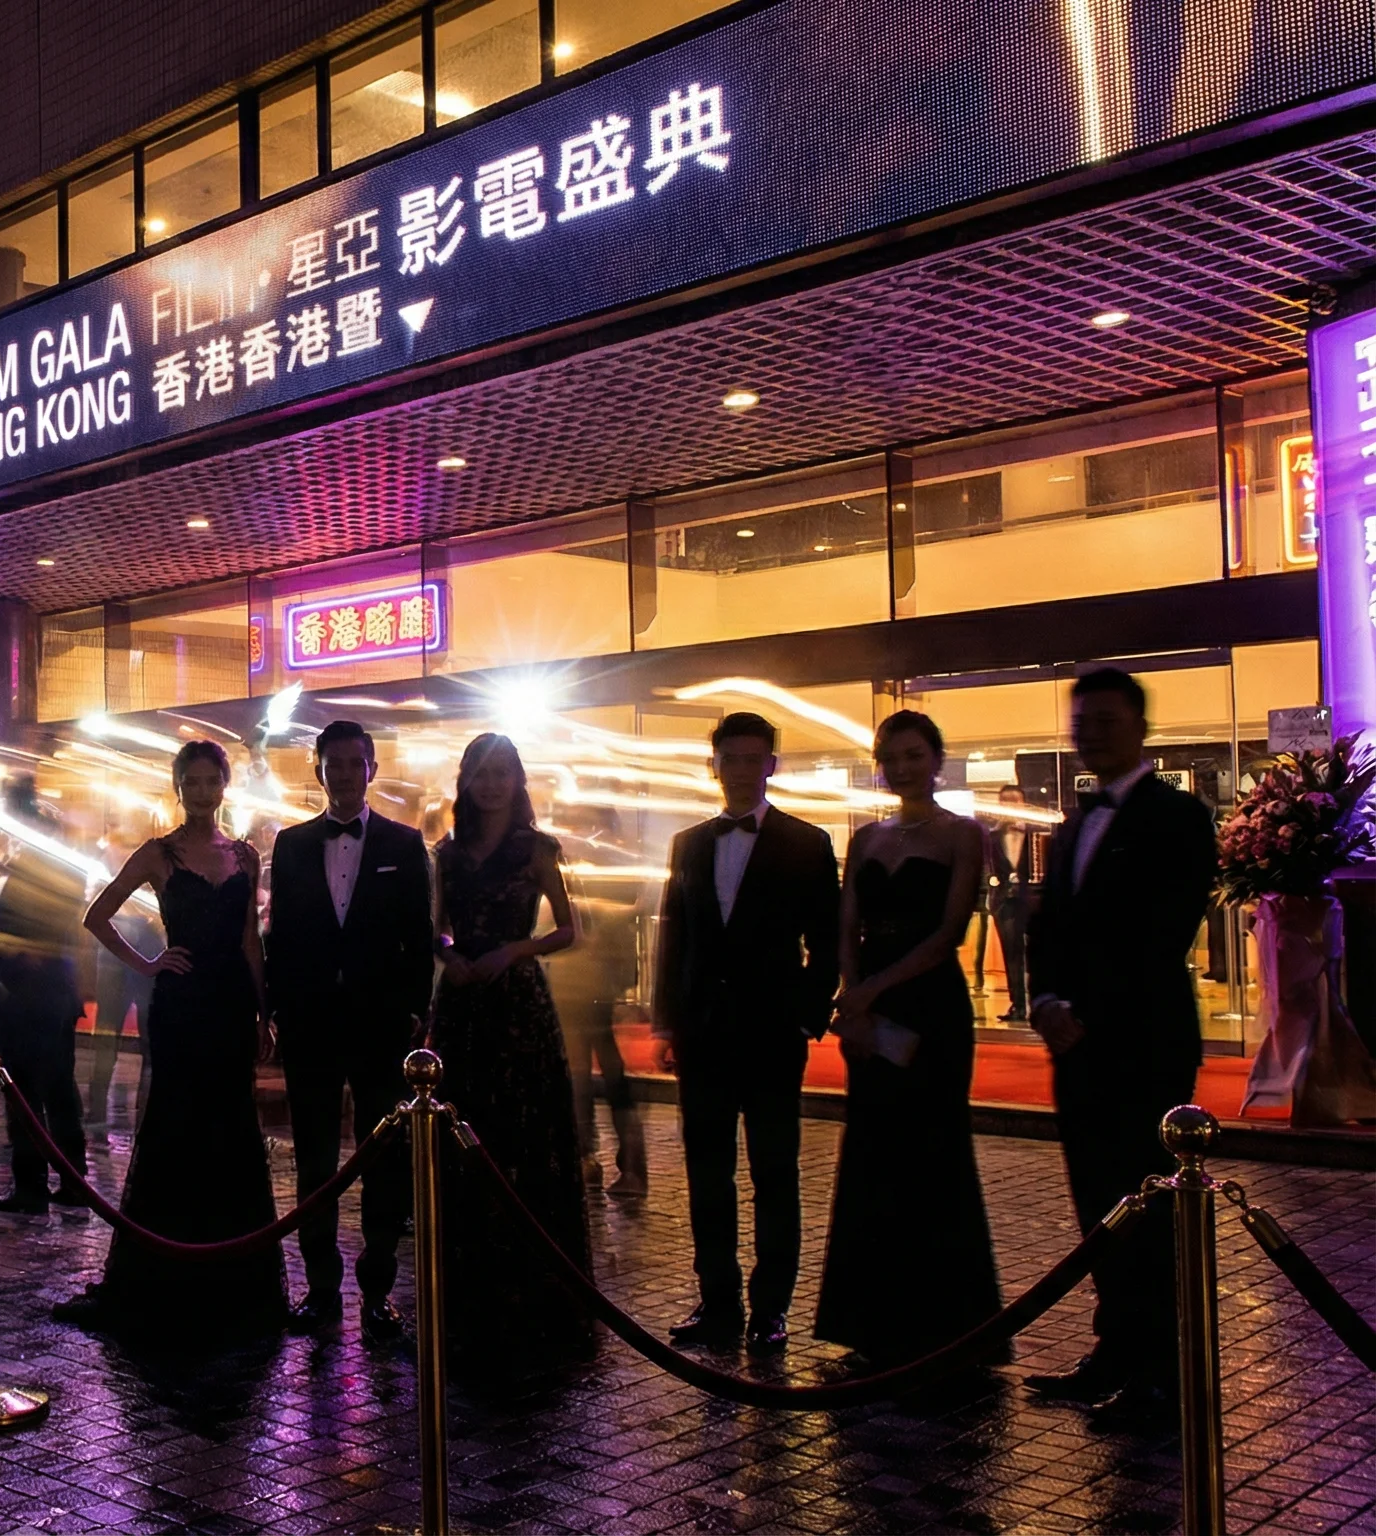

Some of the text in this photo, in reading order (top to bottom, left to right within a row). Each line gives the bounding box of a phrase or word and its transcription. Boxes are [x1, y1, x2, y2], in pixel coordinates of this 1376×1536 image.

[397, 83, 731, 276] 影電盛典
[30, 303, 132, 388] GALA
[37, 370, 132, 448] KONG
